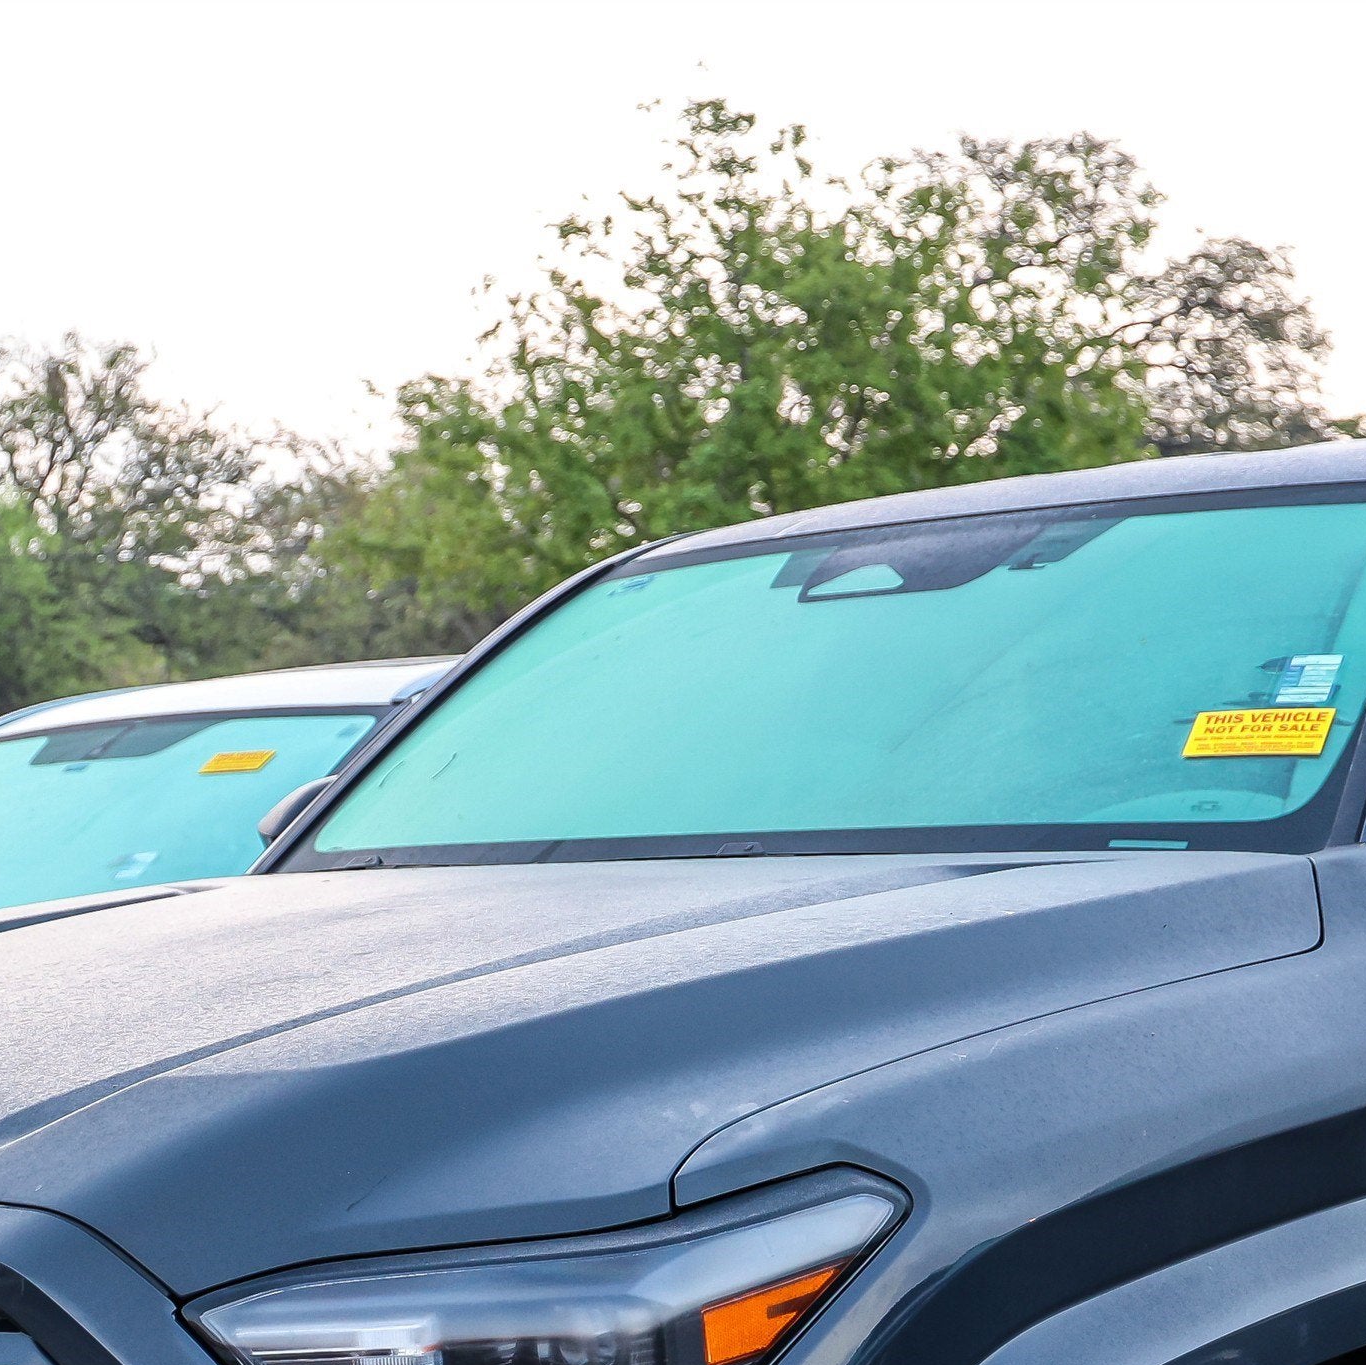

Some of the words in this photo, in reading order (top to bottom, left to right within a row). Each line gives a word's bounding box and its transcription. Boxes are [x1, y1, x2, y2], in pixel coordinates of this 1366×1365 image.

[1205, 713, 1244, 725] THIS
[1250, 711, 1329, 723] VEHICLE
[1203, 725, 1235, 735] NOT
[1240, 724, 1272, 733] FOR
[1278, 723, 1321, 732] SALE
